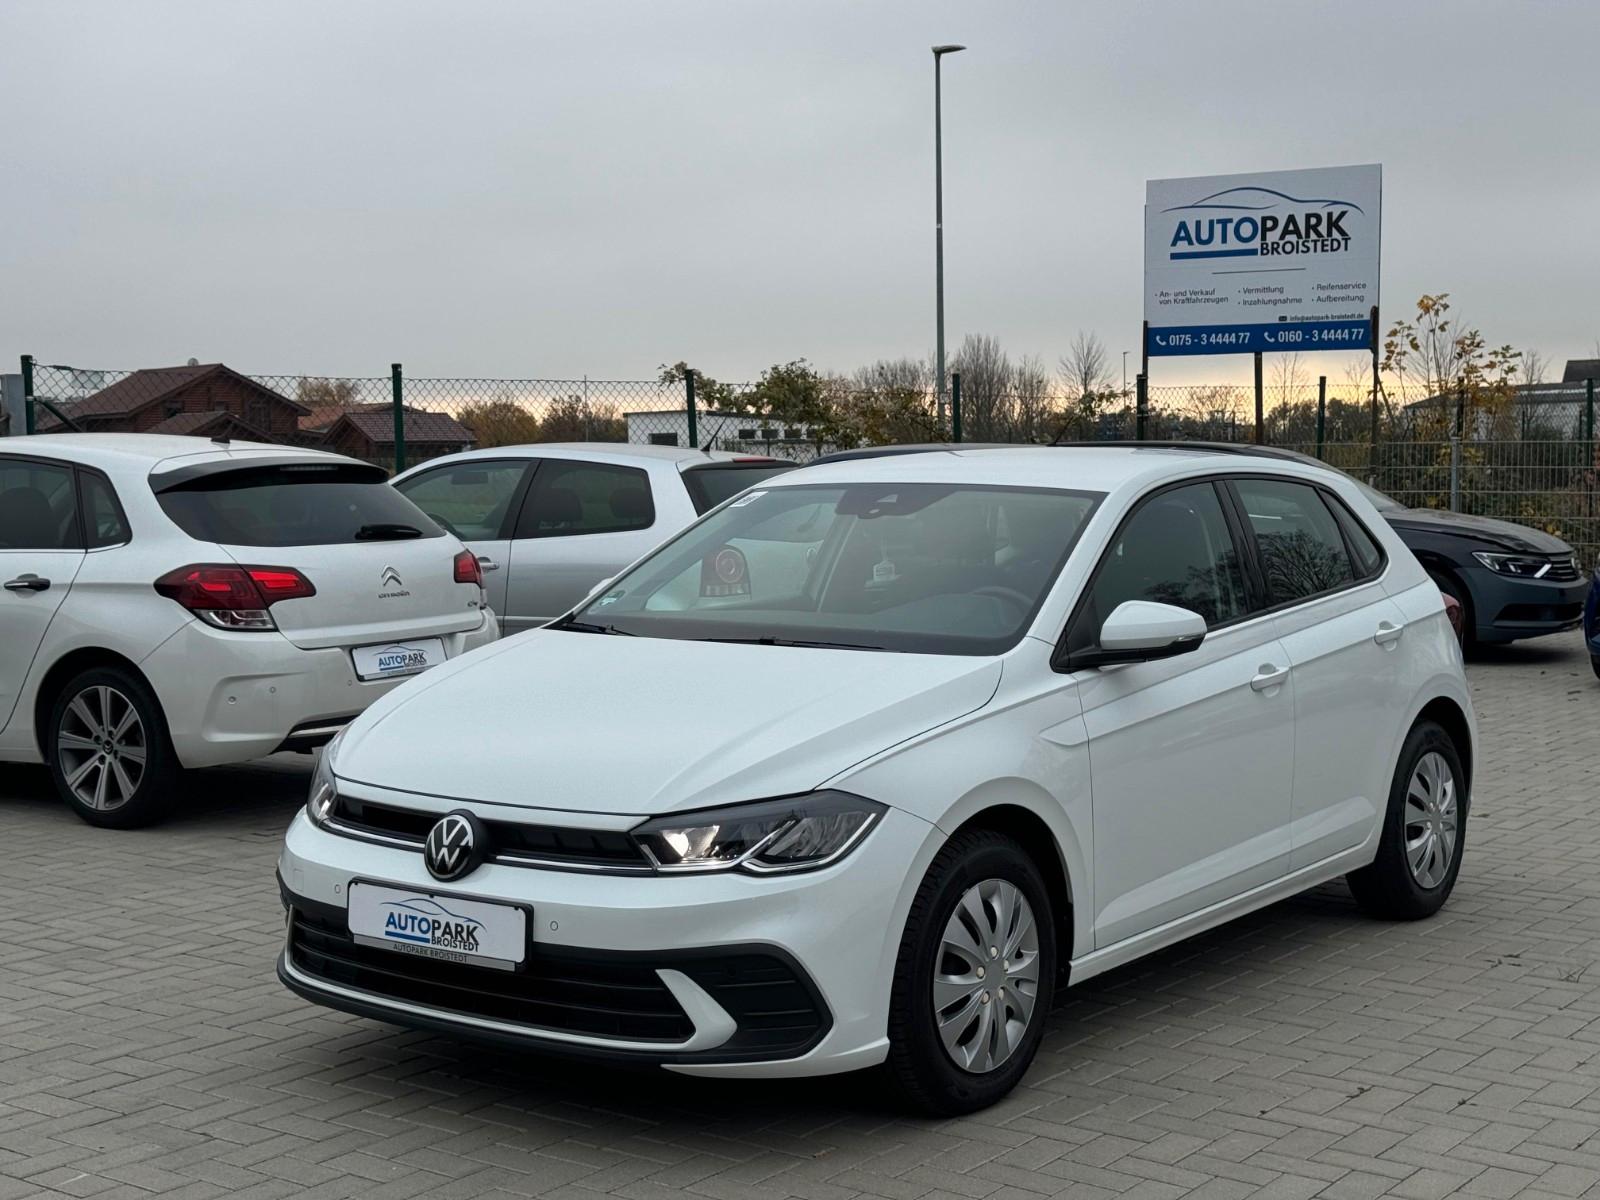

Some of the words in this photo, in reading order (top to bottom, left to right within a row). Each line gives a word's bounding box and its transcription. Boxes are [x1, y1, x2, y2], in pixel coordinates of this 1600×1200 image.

[1170, 210, 1350, 247] AUTOPARK
[1260, 237, 1351, 256] BROISTEDT
[1173, 289, 1187, 297] und
[1188, 288, 1216, 296] Verkauf
[1242, 286, 1284, 294] Vermittlung
[1316, 282, 1367, 291] Reifenservice
[1173, 296, 1229, 305] Kraftfahrzeugen
[1242, 297, 1303, 306] Inzahlungnahme
[1316, 294, 1365, 303] Aufbereitung
[1169, 334, 1192, 346] 0175
[1278, 330, 1302, 342] 0160
[378, 652, 427, 667] AUTOPARK
[385, 912, 479, 944] AUTOPARK
[431, 935, 480, 953] BROISTEDT
[393, 943, 430, 956] AUTOPARK
[430, 949, 468, 963] BROISTEDT
